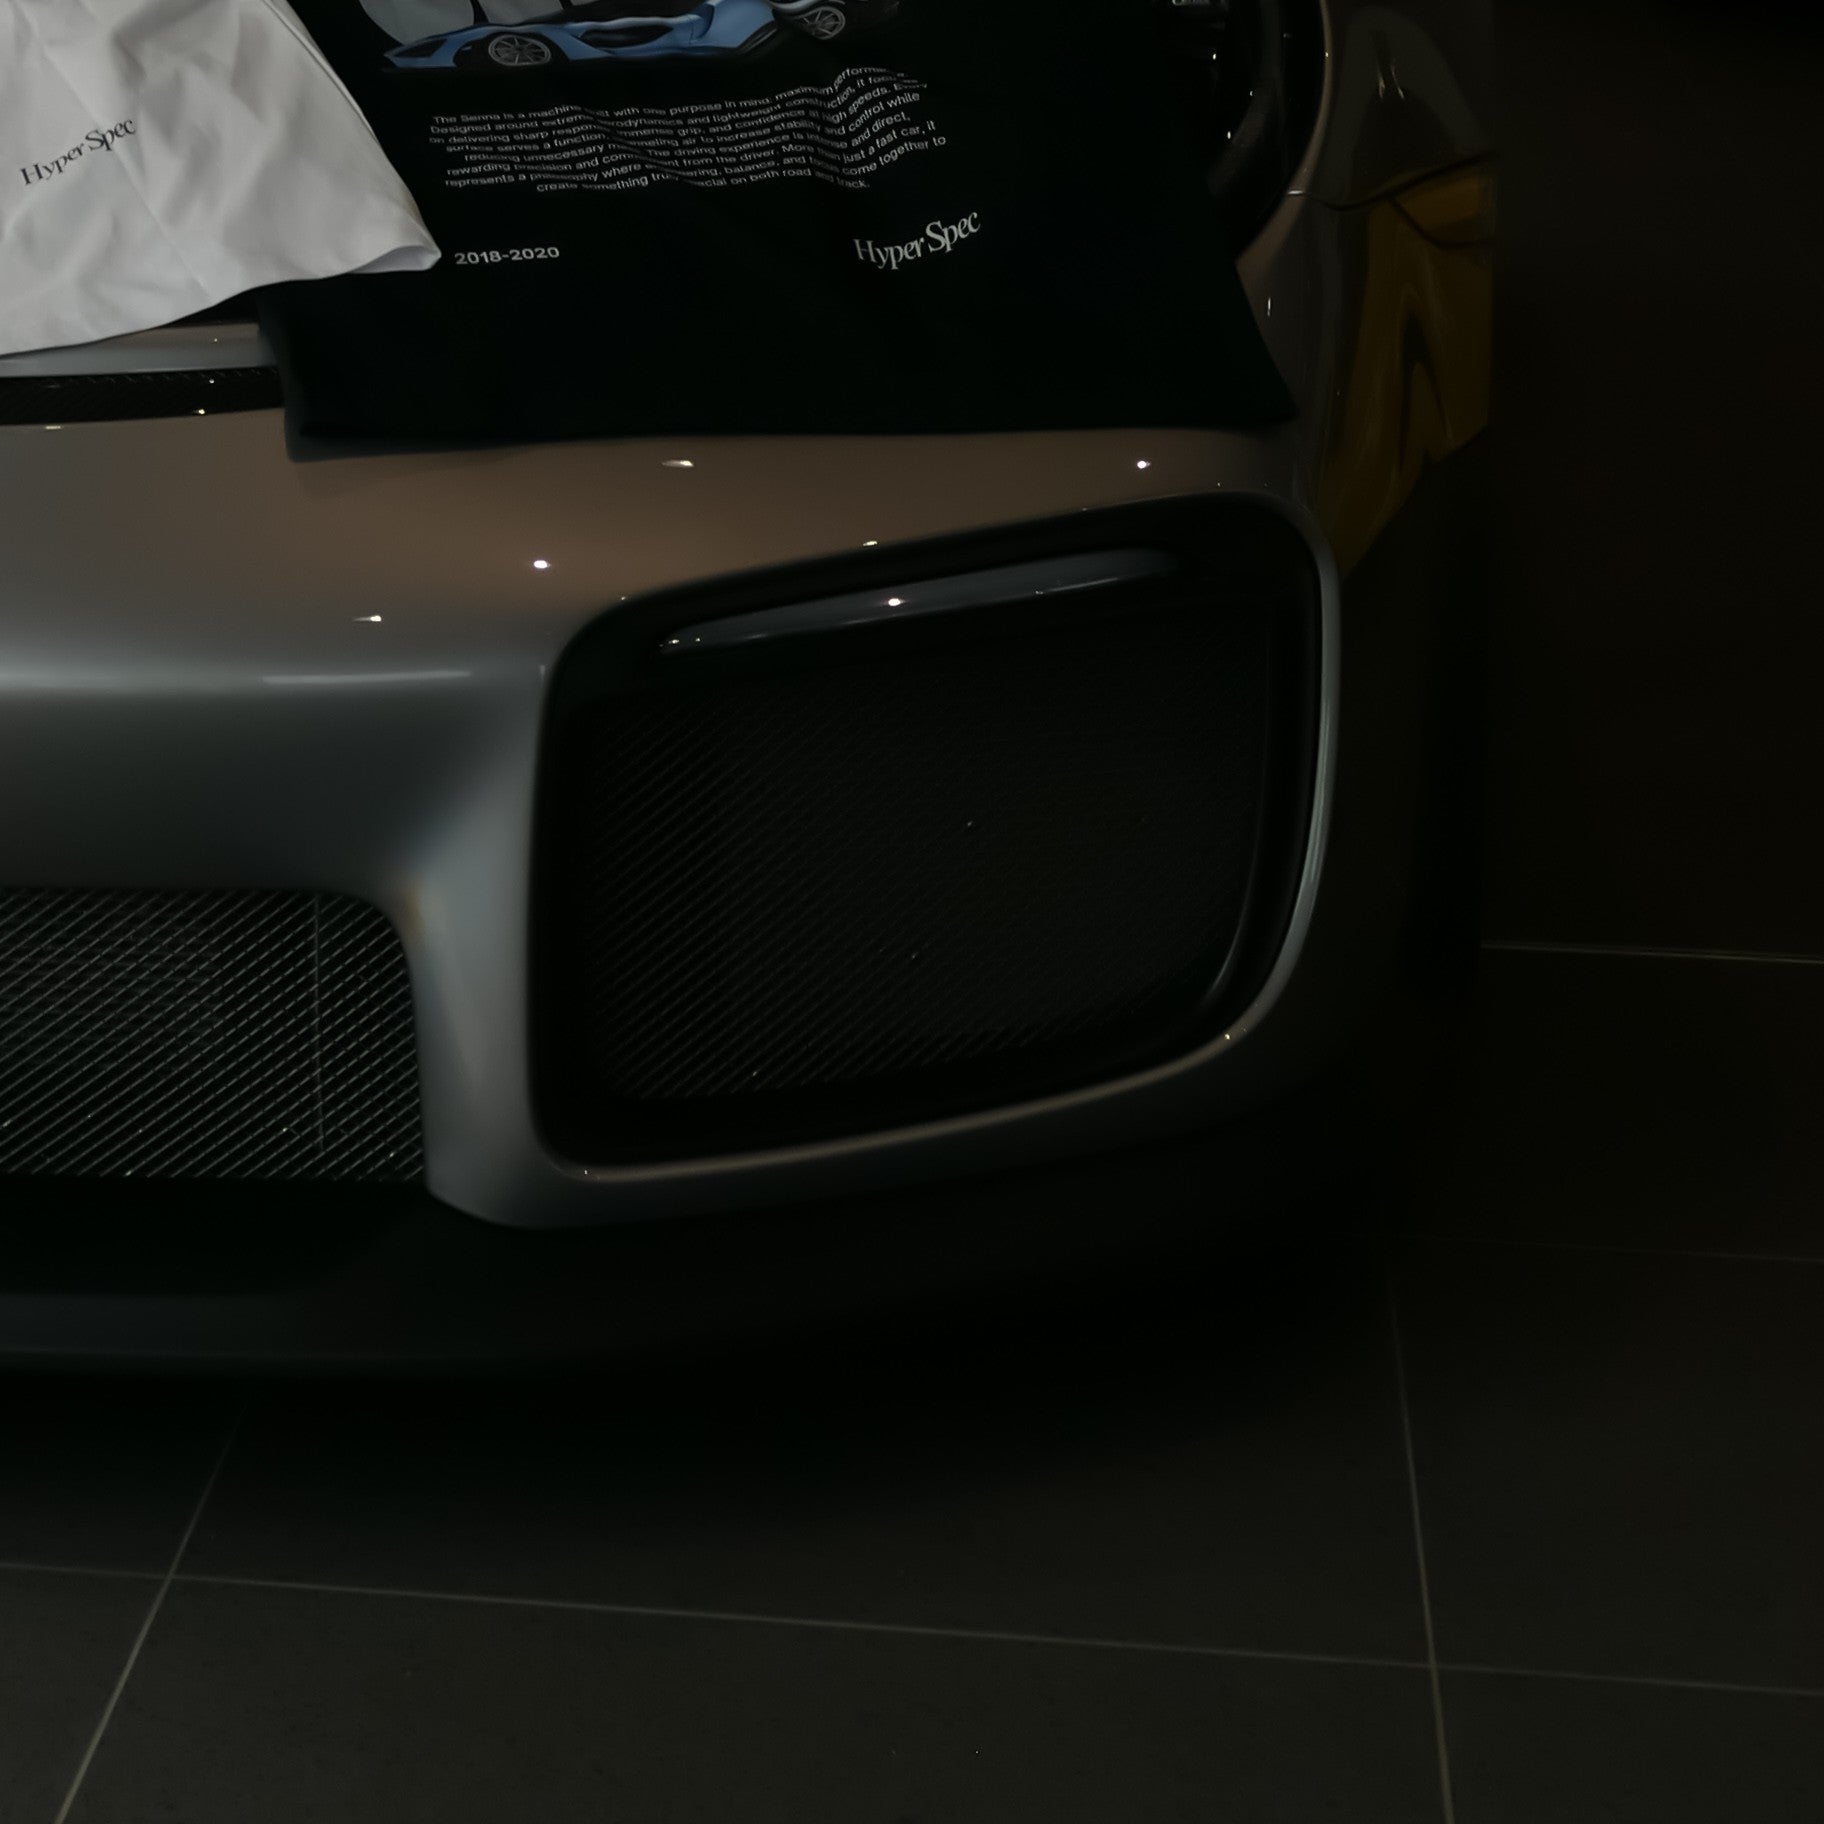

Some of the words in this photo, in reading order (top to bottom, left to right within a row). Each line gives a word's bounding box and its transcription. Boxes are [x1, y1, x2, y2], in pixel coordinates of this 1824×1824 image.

[430, 123, 491, 134] Designed
[495, 121, 539, 130] around
[687, 115, 710, 125] and
[613, 107, 640, 117] with
[669, 103, 722, 115] purpose
[848, 101, 885, 132] control
[887, 92, 921, 108] while
[20, 143, 84, 186] Hyper
[84, 119, 137, 151] Spec
[448, 135, 510, 143] delivering
[513, 132, 549, 141] sharp
[523, 143, 604, 162] unnecessary
[719, 134, 790, 152] experience
[851, 128, 871, 147] and
[445, 174, 515, 188] represents
[601, 163, 642, 179] where
[782, 155, 806, 165] and
[842, 161, 877, 176] come
[878, 140, 929, 166] together
[932, 136, 947, 147] to
[447, 163, 511, 176] rewarding
[575, 157, 599, 170] and
[781, 143, 815, 154] More
[868, 145, 875, 156] a
[536, 182, 578, 192] create
[782, 167, 812, 177] road
[454, 246, 560, 265] 2018-2020
[852, 236, 925, 271] Hyper
[925, 211, 981, 253] Spec
